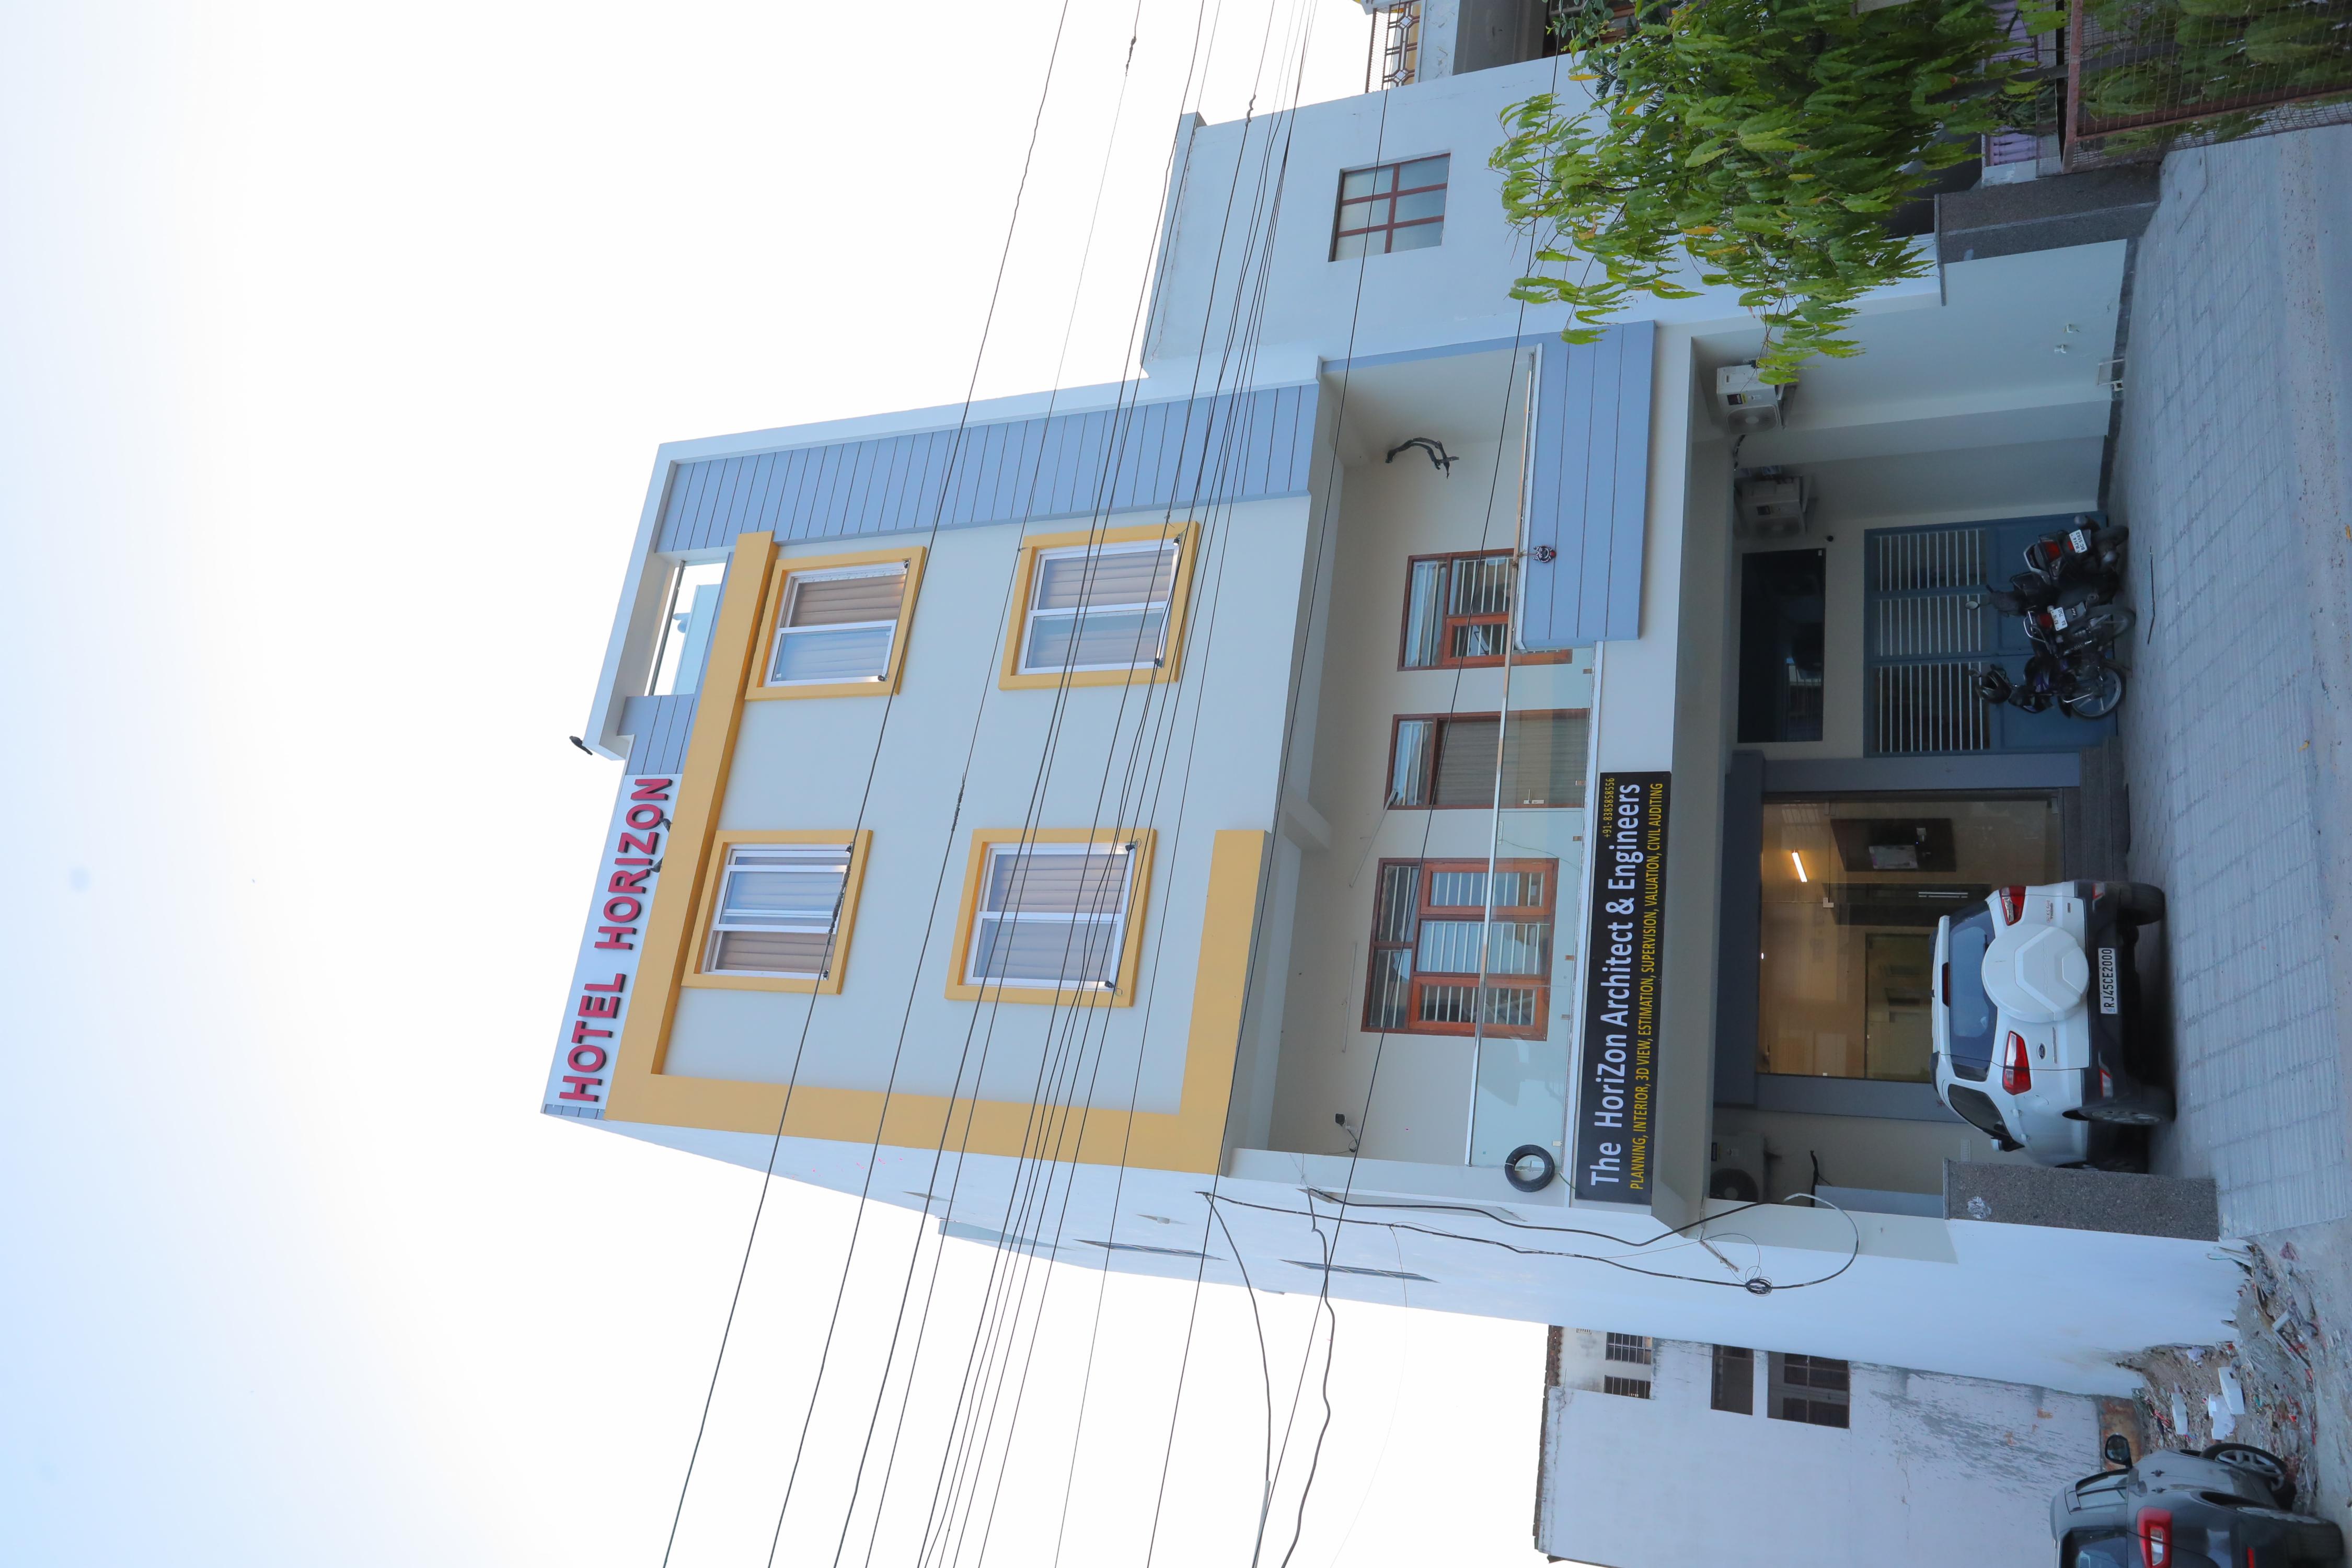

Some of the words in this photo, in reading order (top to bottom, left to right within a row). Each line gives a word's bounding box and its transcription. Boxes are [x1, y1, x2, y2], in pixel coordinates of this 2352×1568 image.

[1648, 783, 1664, 827] AUDITING
[1608, 785, 1644, 889] Engineers
[1647, 828, 1662, 851] CIVIL
[1605, 897, 1634, 915] &
[1644, 854, 1662, 906] VALUATION,
[559, 973, 625, 1102] HOTEL
[594, 778, 672, 950] HORIZON
[1641, 909, 1659, 973] SUPERVISION,
[1600, 922, 1633, 1027] Architect
[2101, 949, 2114, 1008] RJ45CE2000
[1637, 976, 1656, 1036] ESTIMATION,
[1635, 1067, 1650, 1080] 3D
[1636, 1039, 1653, 1065] VIEW,
[1594, 1034, 1627, 1127] HoriZon
[1633, 1083, 1651, 1132] INTERIOR,
[1589, 1142, 1621, 1186] The
[1630, 1135, 1648, 1190] PLANNING,
